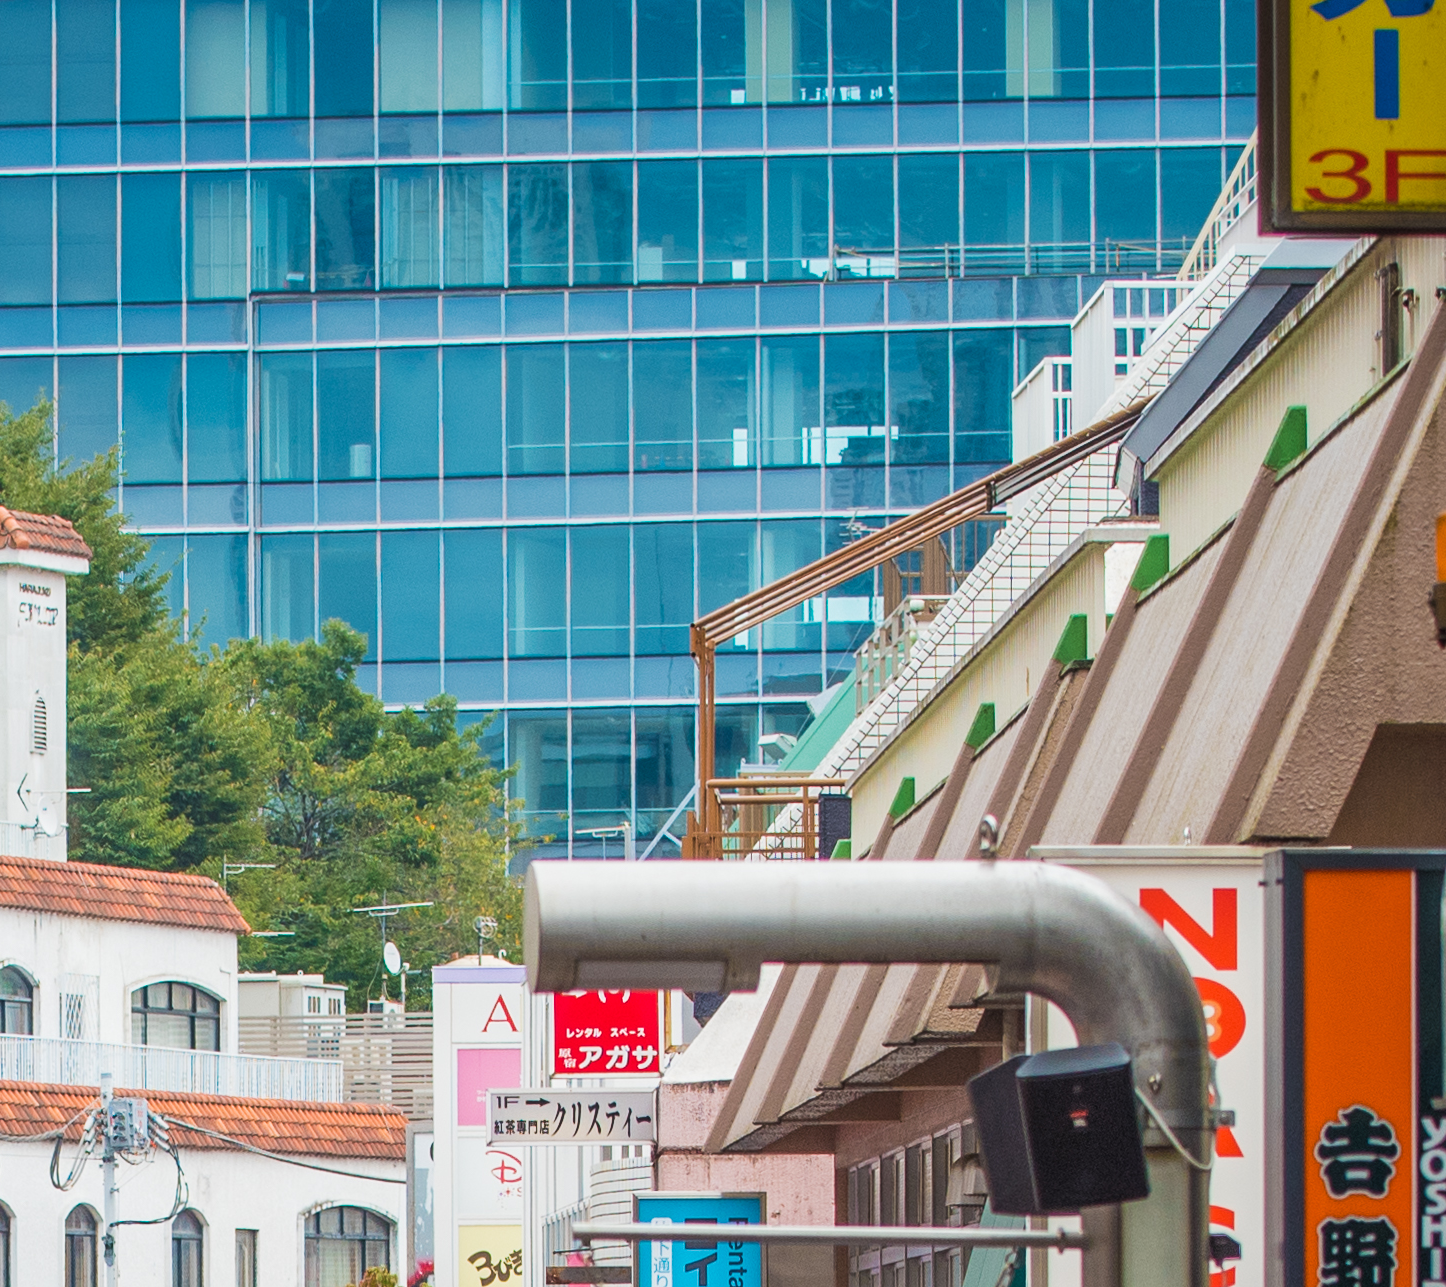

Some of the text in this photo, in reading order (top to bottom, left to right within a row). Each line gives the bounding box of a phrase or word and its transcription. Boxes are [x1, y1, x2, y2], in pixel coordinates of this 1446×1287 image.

[566, 1027, 646, 1038] レンタル スペース
[578, 1045, 657, 1070] アガサ
[494, 1102, 651, 1137] 紅茶専門店 クリスティー
